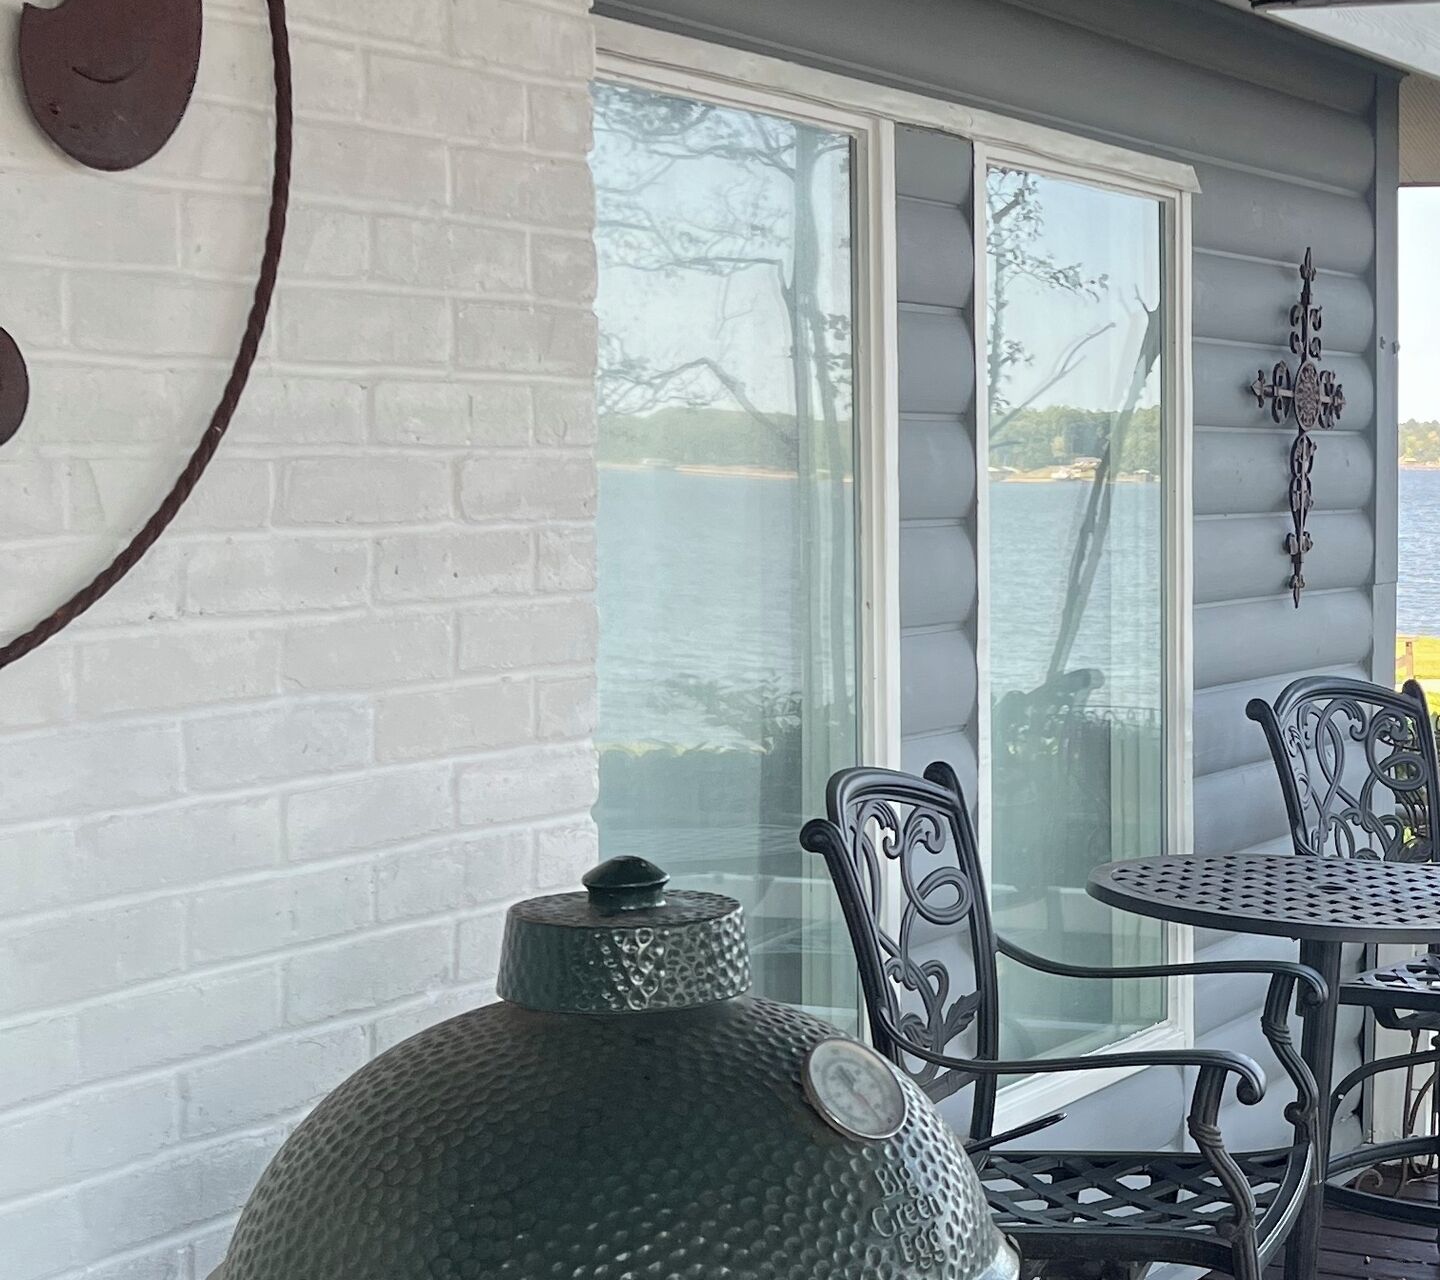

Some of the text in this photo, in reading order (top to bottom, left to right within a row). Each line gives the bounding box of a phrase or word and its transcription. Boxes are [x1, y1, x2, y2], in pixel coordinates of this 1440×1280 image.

[874, 1160, 921, 1200] Big
[872, 1193, 944, 1238] Green
[900, 1224, 946, 1269] Egg
